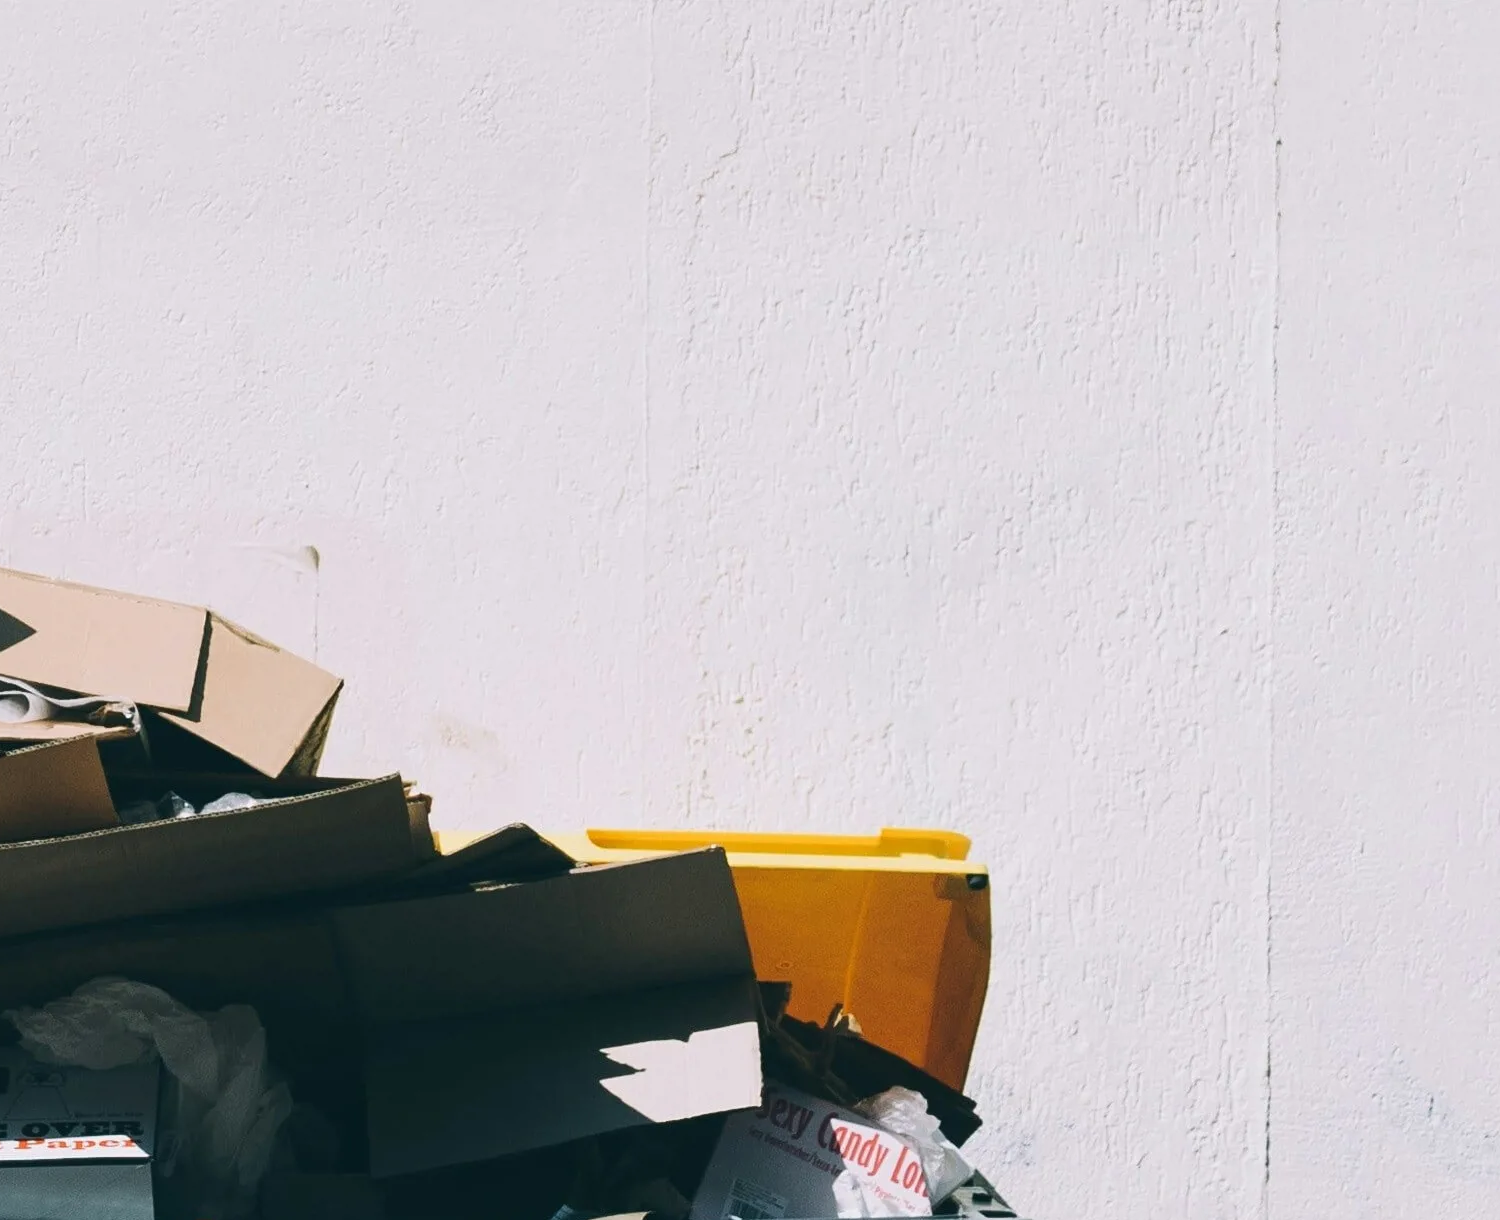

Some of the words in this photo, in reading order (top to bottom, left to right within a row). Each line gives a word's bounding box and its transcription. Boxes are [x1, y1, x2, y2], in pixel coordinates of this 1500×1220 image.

[21, 1121, 144, 1138] OVER
[14, 1136, 144, 1151] Paper
[817, 1111, 889, 1177] Candy
